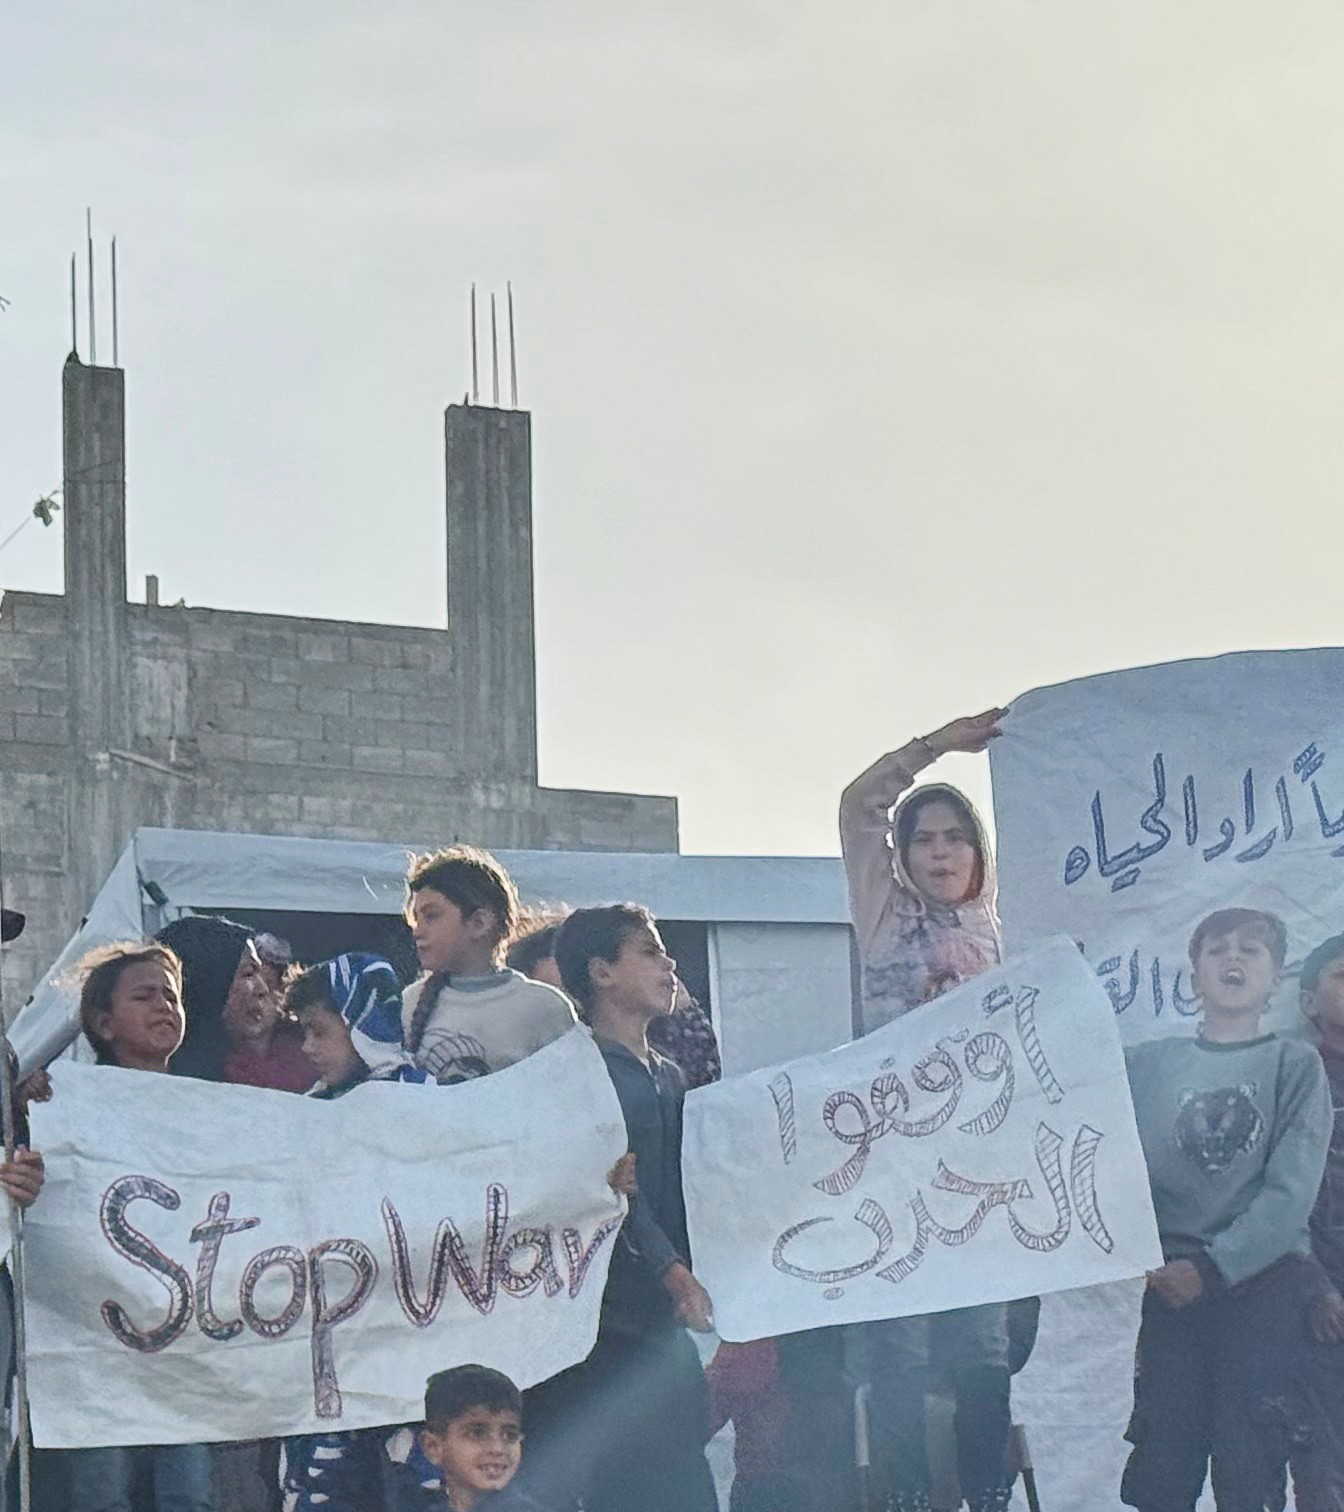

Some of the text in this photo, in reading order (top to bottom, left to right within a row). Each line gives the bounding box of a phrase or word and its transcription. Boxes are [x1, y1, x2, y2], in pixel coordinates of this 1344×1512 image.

[100, 1174, 625, 1420] Stop War
[771, 1120, 1115, 1301] الحرب
